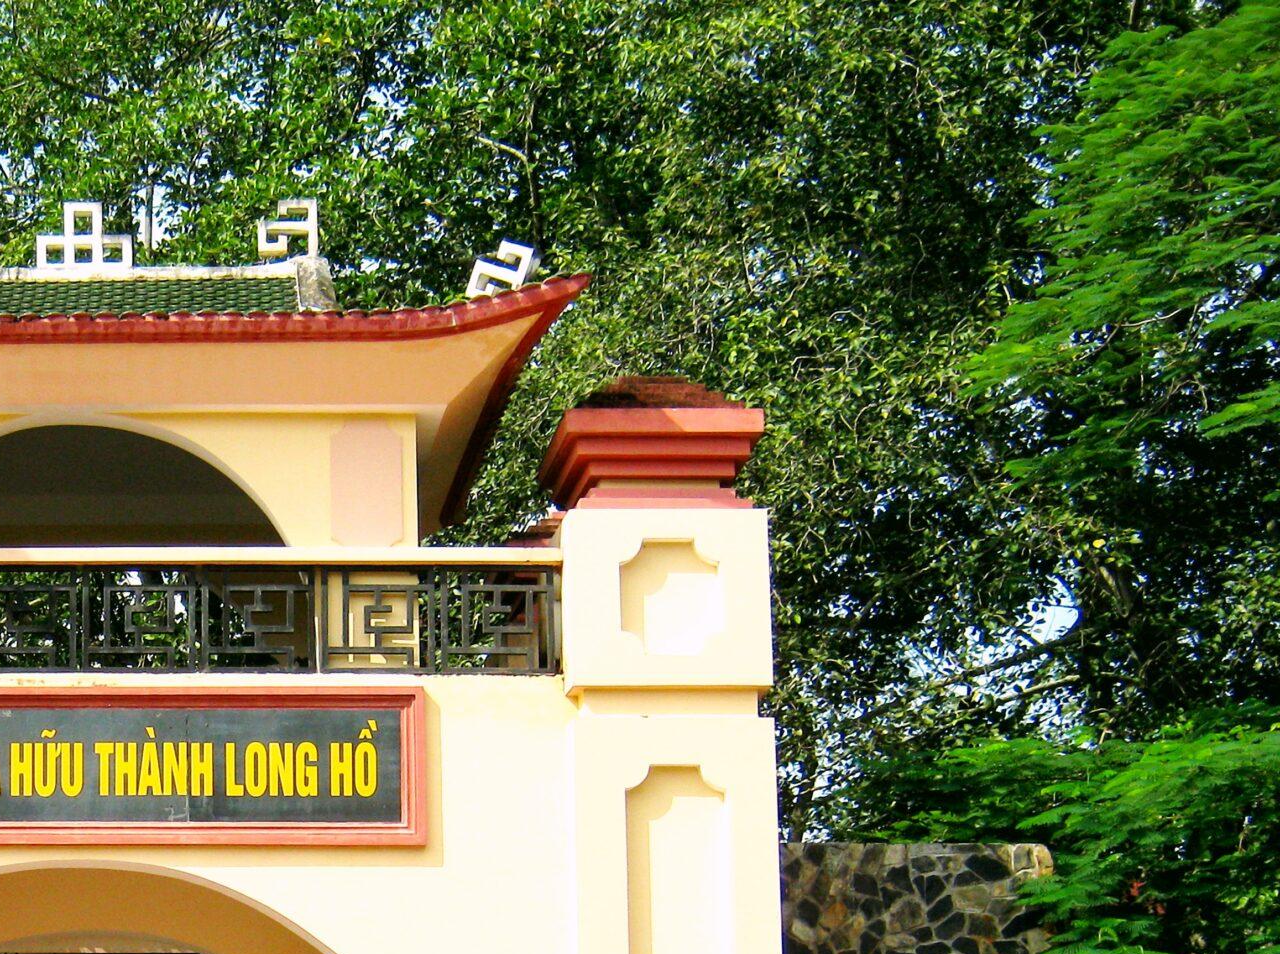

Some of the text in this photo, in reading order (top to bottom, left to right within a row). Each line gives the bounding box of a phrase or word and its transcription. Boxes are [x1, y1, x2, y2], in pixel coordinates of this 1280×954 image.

[8, 729, 86, 799] HỮU
[93, 726, 216, 798] THÀNH
[224, 740, 320, 799] LONG
[329, 719, 379, 799] HỒ
